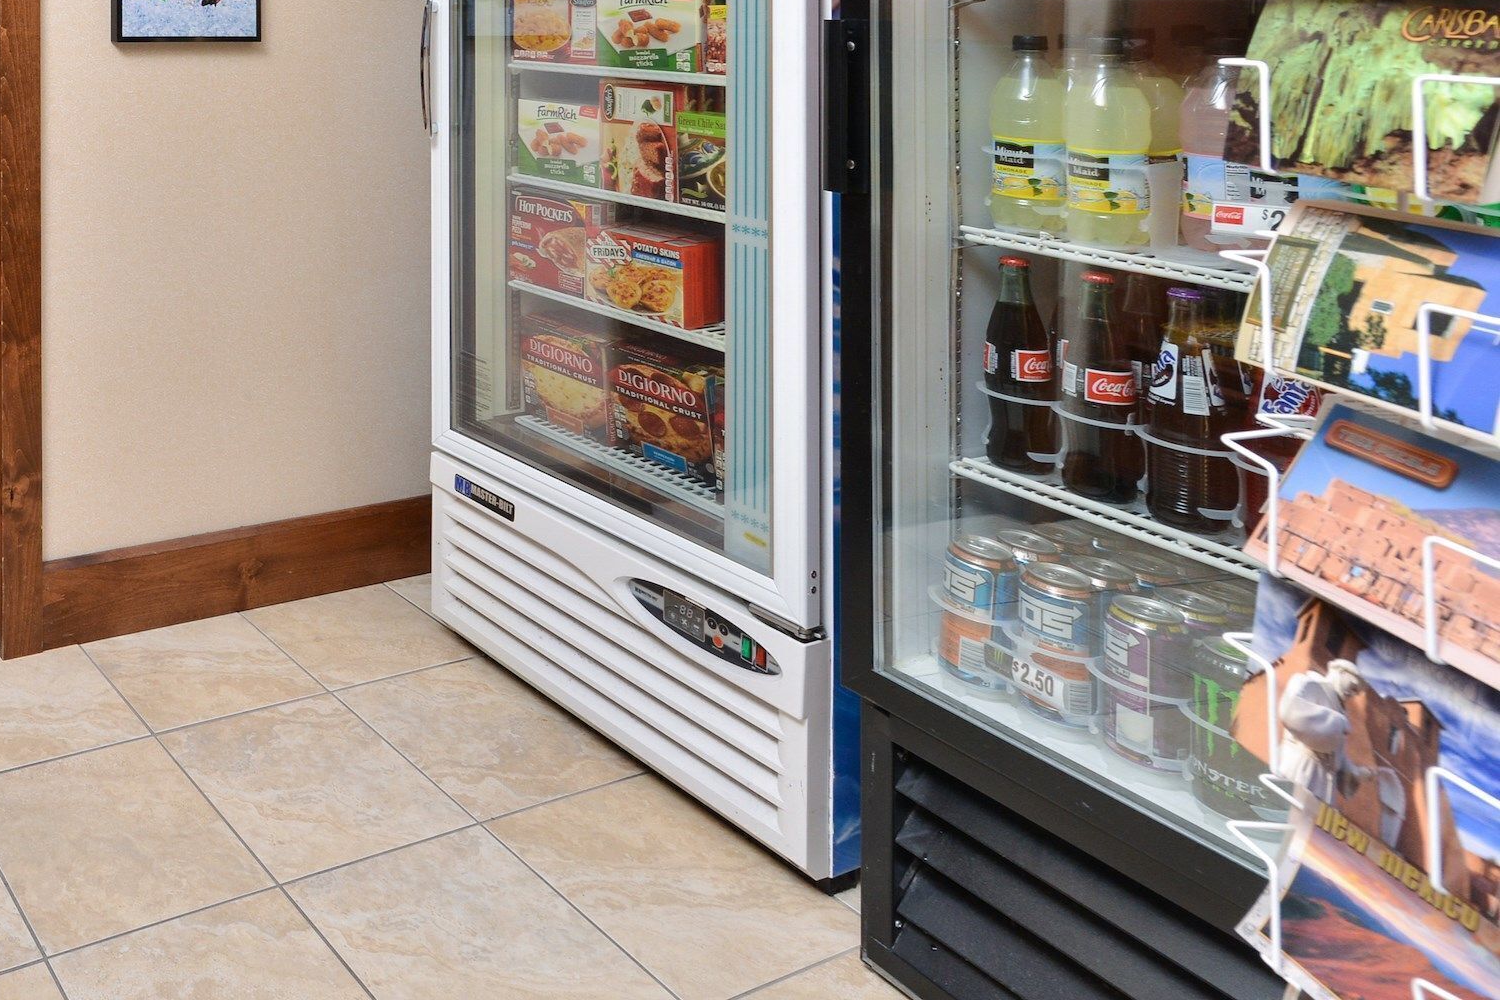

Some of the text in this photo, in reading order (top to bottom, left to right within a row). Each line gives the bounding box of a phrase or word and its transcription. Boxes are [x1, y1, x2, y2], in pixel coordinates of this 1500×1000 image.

[697, 117, 715, 129] Chile
[1000, 155, 1024, 165] Maid
[1072, 165, 1101, 178] Maid
[537, 204, 573, 223] POCKETS
[632, 241, 681, 260] POTATO SKINS
[526, 353, 598, 386] TRADITIONAL CRUST
[615, 385, 703, 421] TRADITIONAL CRUST
[471, 483, 514, 516] MASTER-BILT
[1012, 659, 1055, 698] $2.50
[1193, 758, 1268, 801] NSTER
